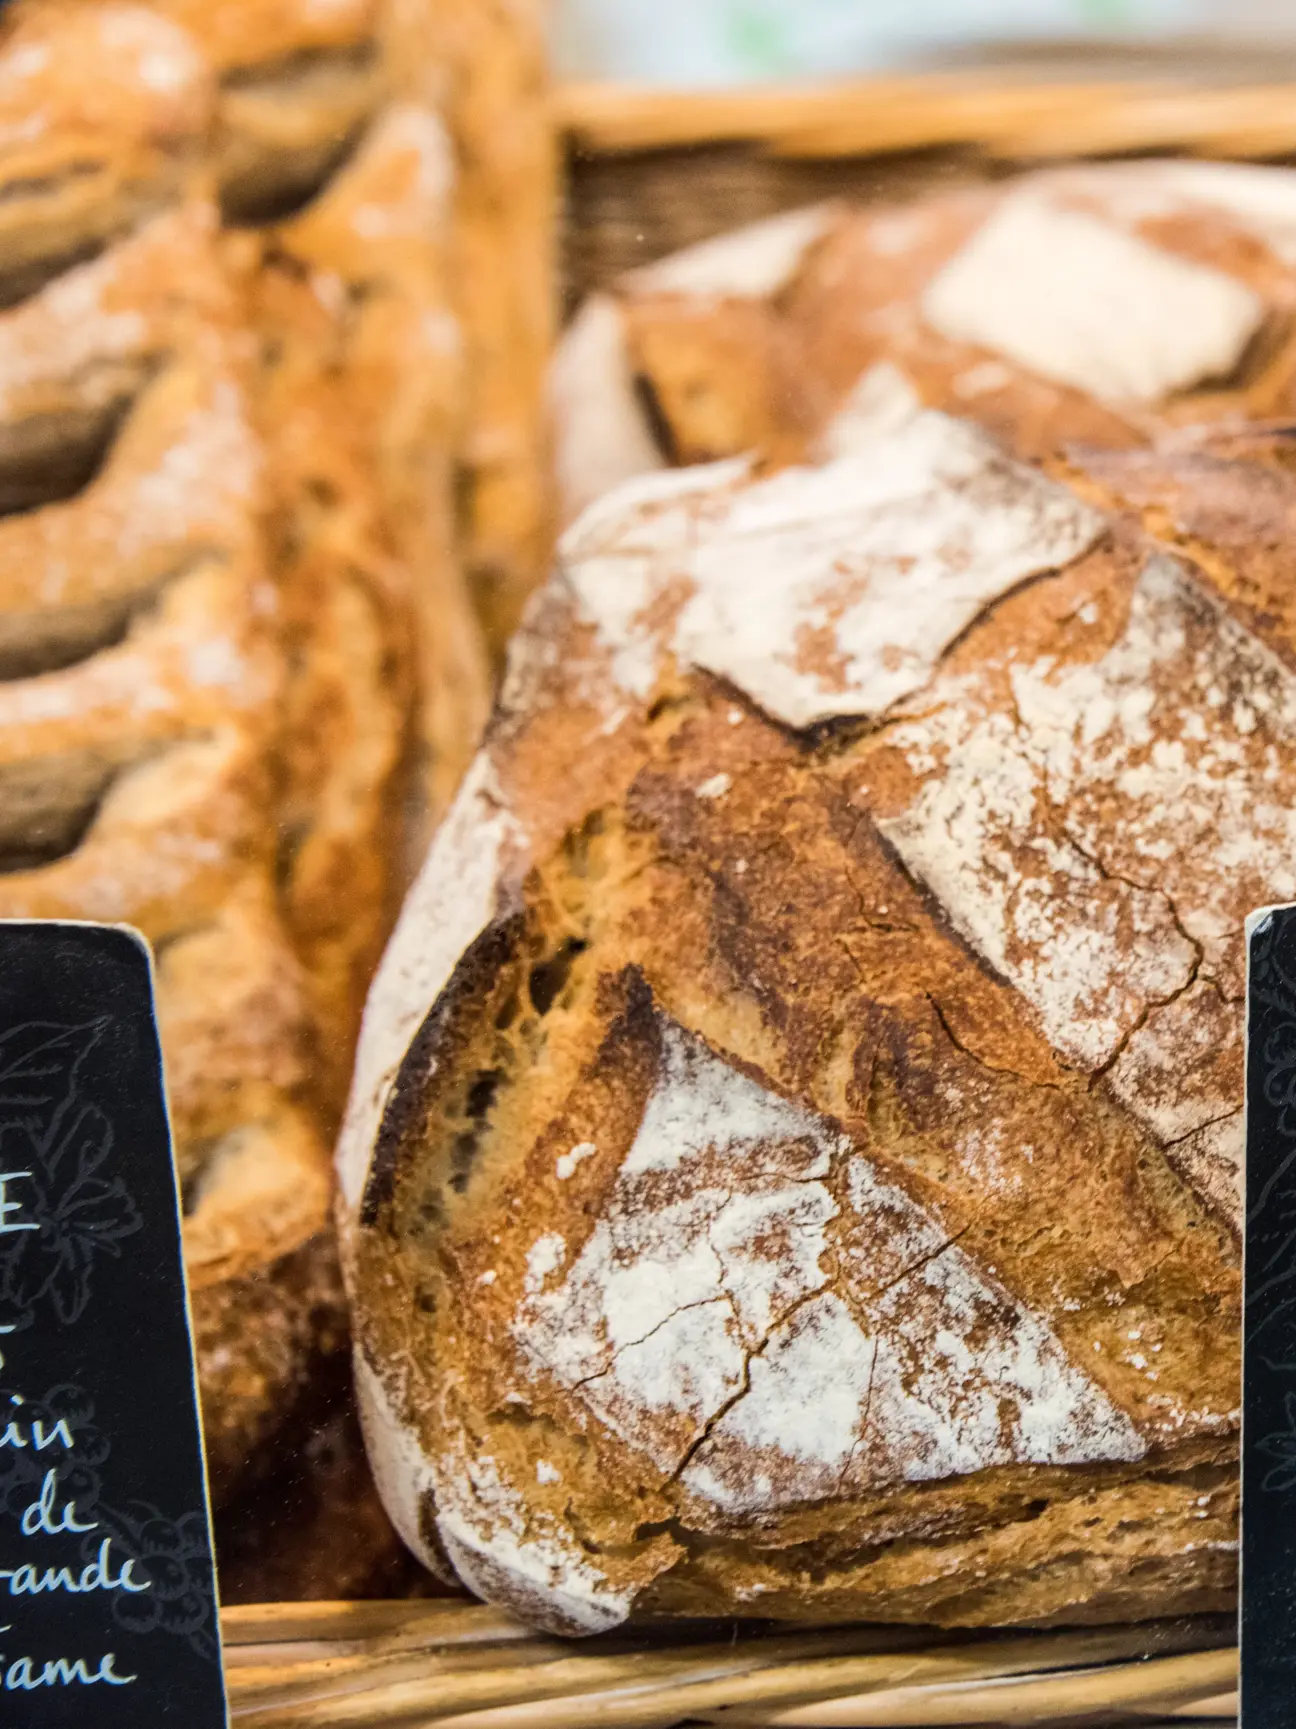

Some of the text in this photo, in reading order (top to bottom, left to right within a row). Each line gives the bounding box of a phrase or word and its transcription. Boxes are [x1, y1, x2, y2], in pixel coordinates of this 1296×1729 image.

[21, 1468, 98, 1536] de
[0, 1537, 152, 1596] ande
[0, 1652, 138, 1691] ame
